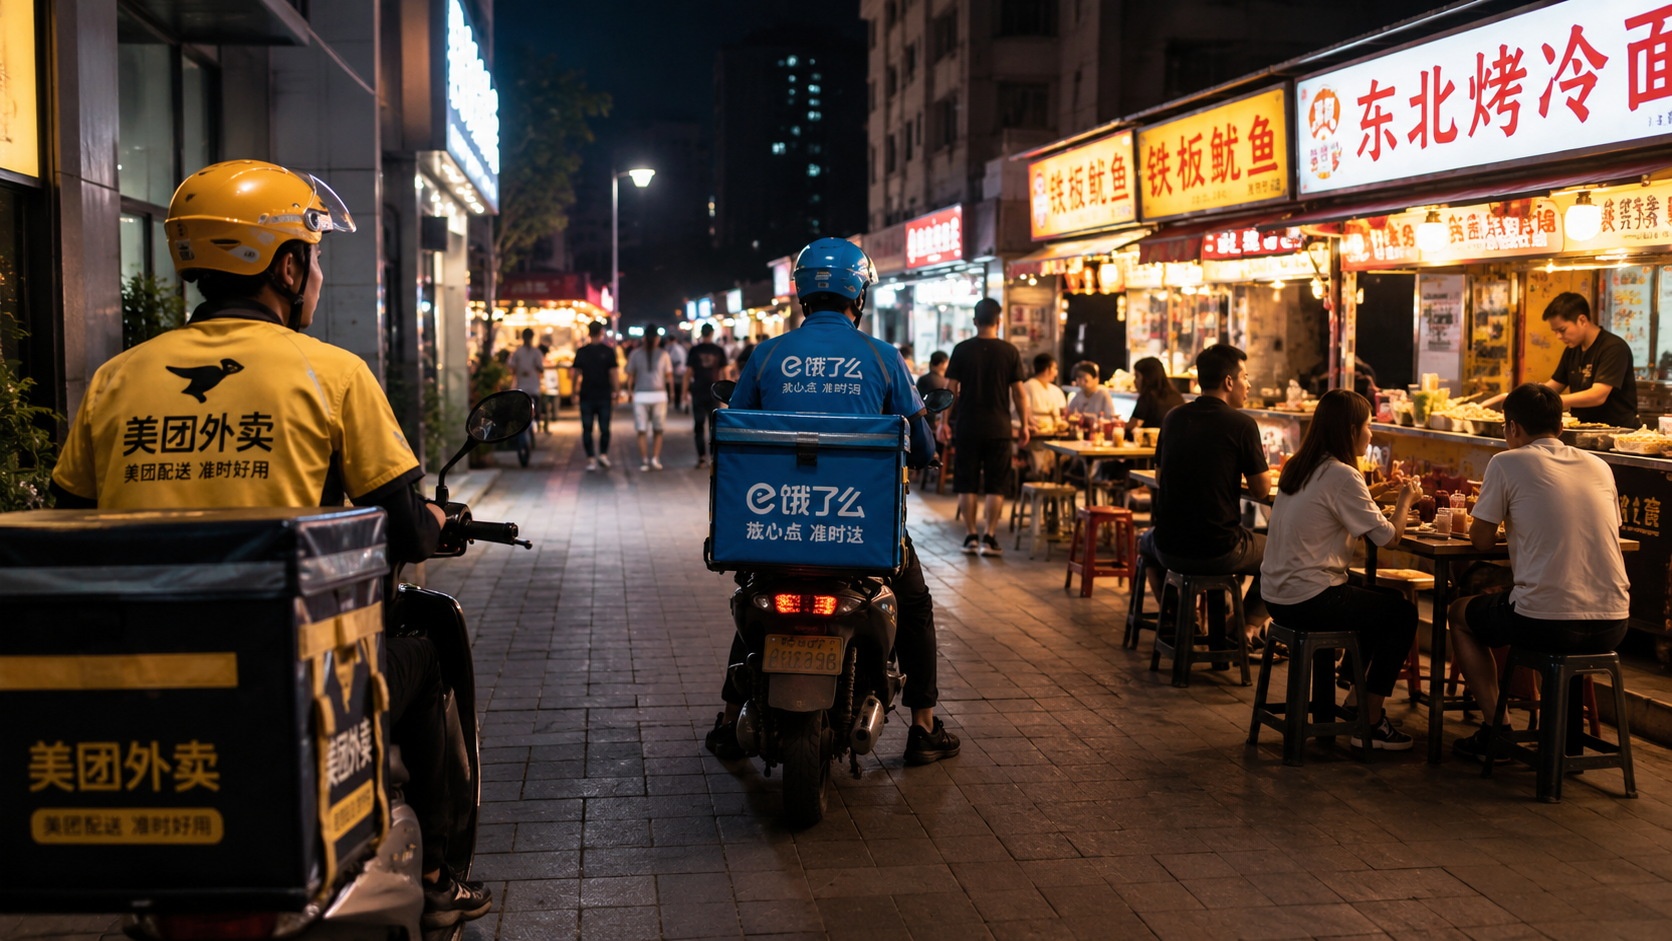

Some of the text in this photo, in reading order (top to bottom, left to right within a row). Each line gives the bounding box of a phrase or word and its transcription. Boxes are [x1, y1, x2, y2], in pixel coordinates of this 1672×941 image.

[1357, 4, 1672, 162] 东北烤冷面
[1147, 114, 1279, 198] 铁板鱿鱼
[1051, 152, 1129, 215] 铁板鱿鱼
[123, 411, 274, 457] 美团外卖
[124, 460, 270, 484] 美团配送 准时好用
[28, 740, 221, 792] 美团外卖
[43, 814, 212, 837] 美团配送 准时好用
